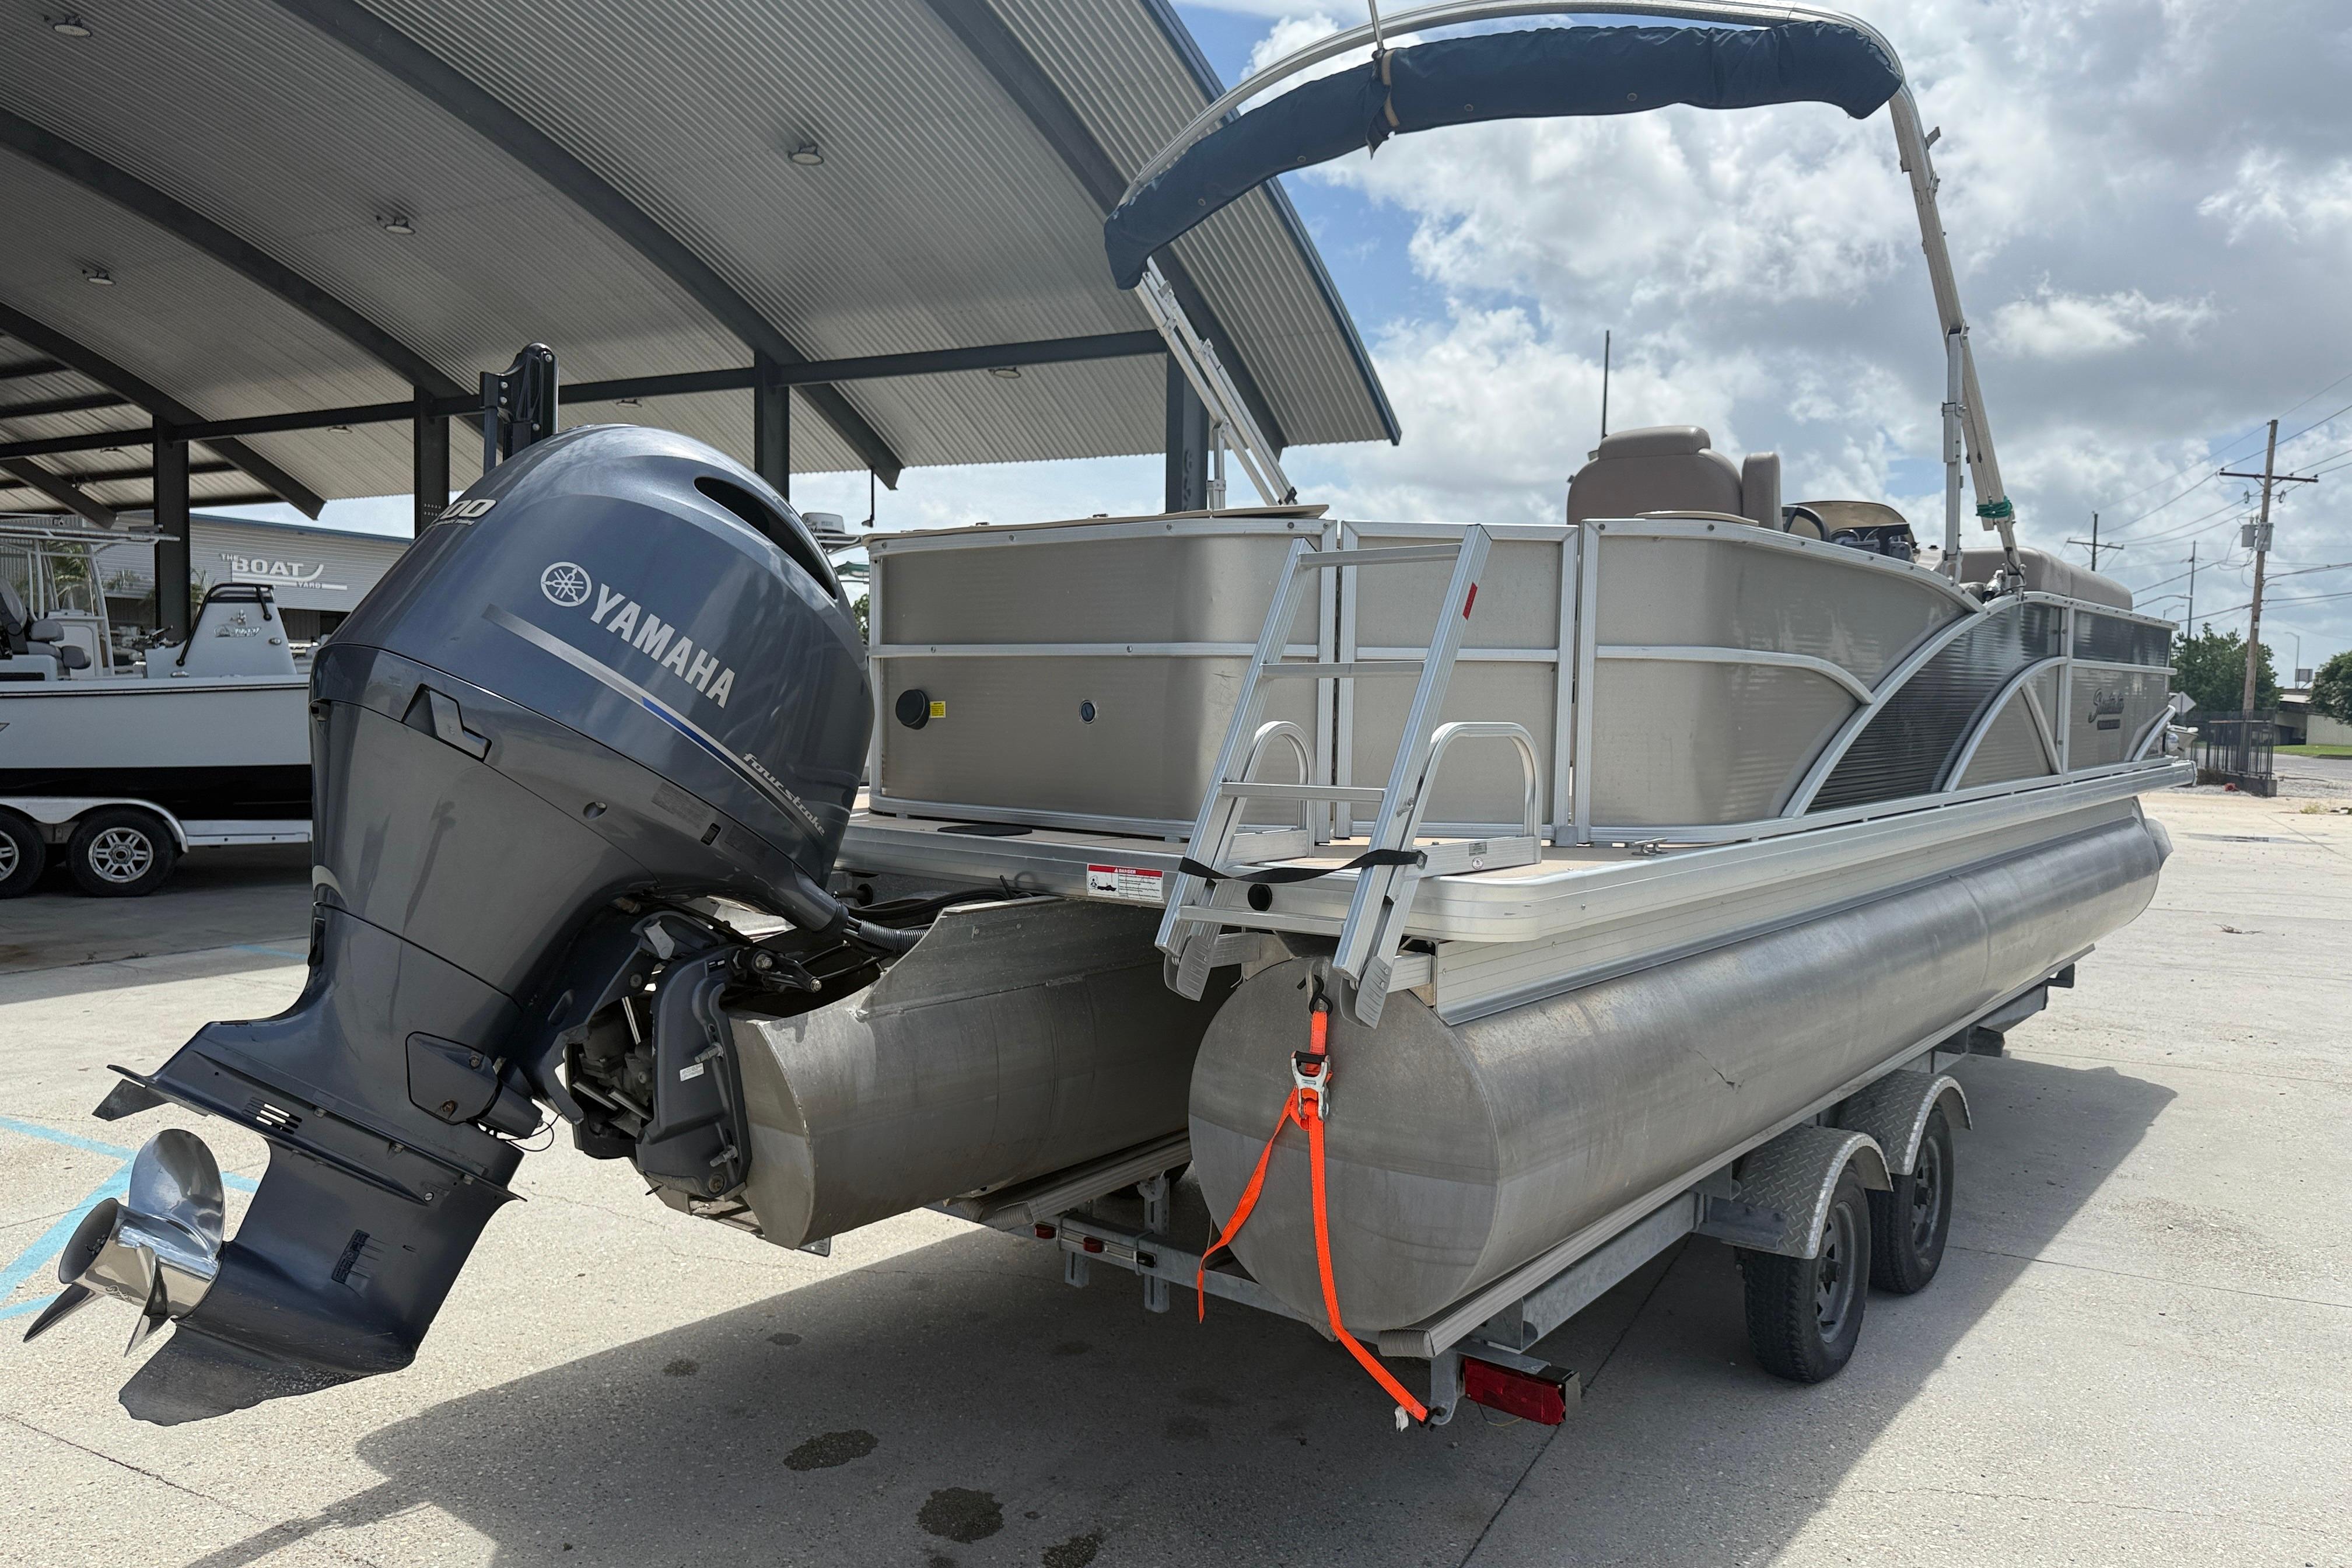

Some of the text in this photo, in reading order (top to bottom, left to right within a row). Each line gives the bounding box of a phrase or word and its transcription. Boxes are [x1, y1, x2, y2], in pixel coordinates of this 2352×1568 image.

[435, 499, 496, 520] 00
[232, 558, 304, 576] BOAT
[590, 583, 736, 709] YAMAHA
